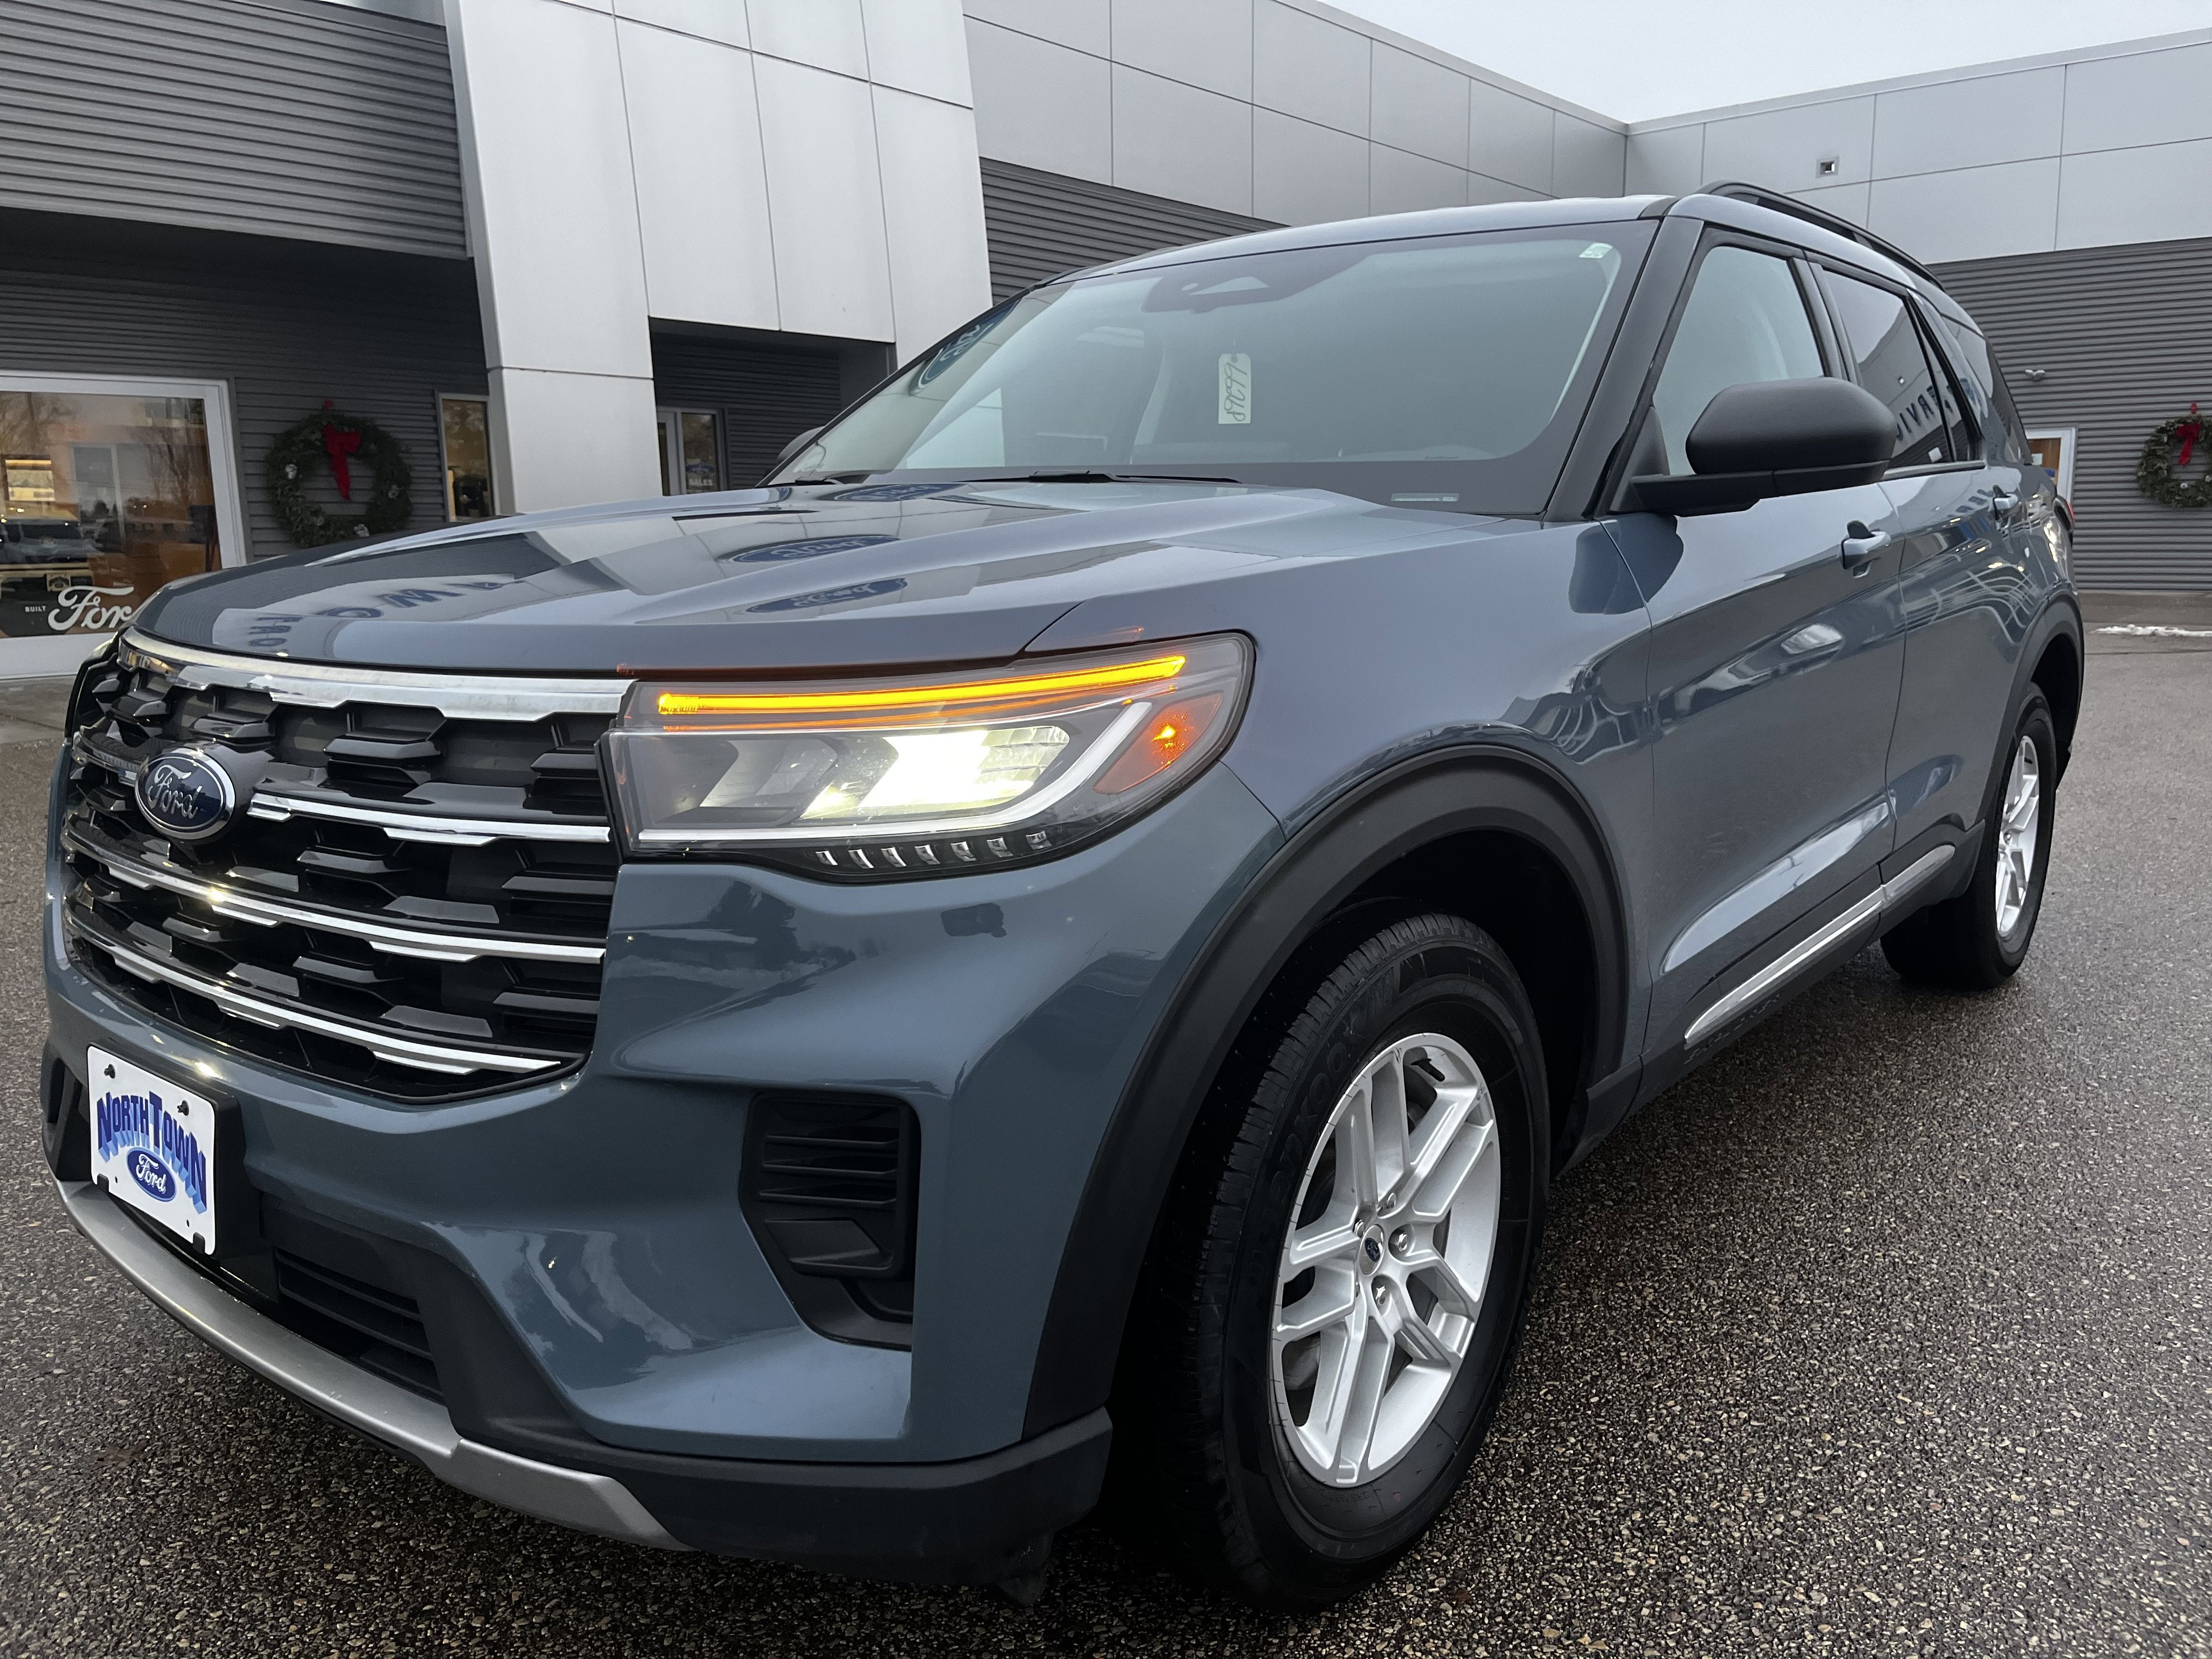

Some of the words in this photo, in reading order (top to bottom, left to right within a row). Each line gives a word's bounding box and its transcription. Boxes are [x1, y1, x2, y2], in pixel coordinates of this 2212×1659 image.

[48, 585, 134, 631] For
[148, 764, 203, 819] Ford
[136, 1153, 167, 1194] Ford
